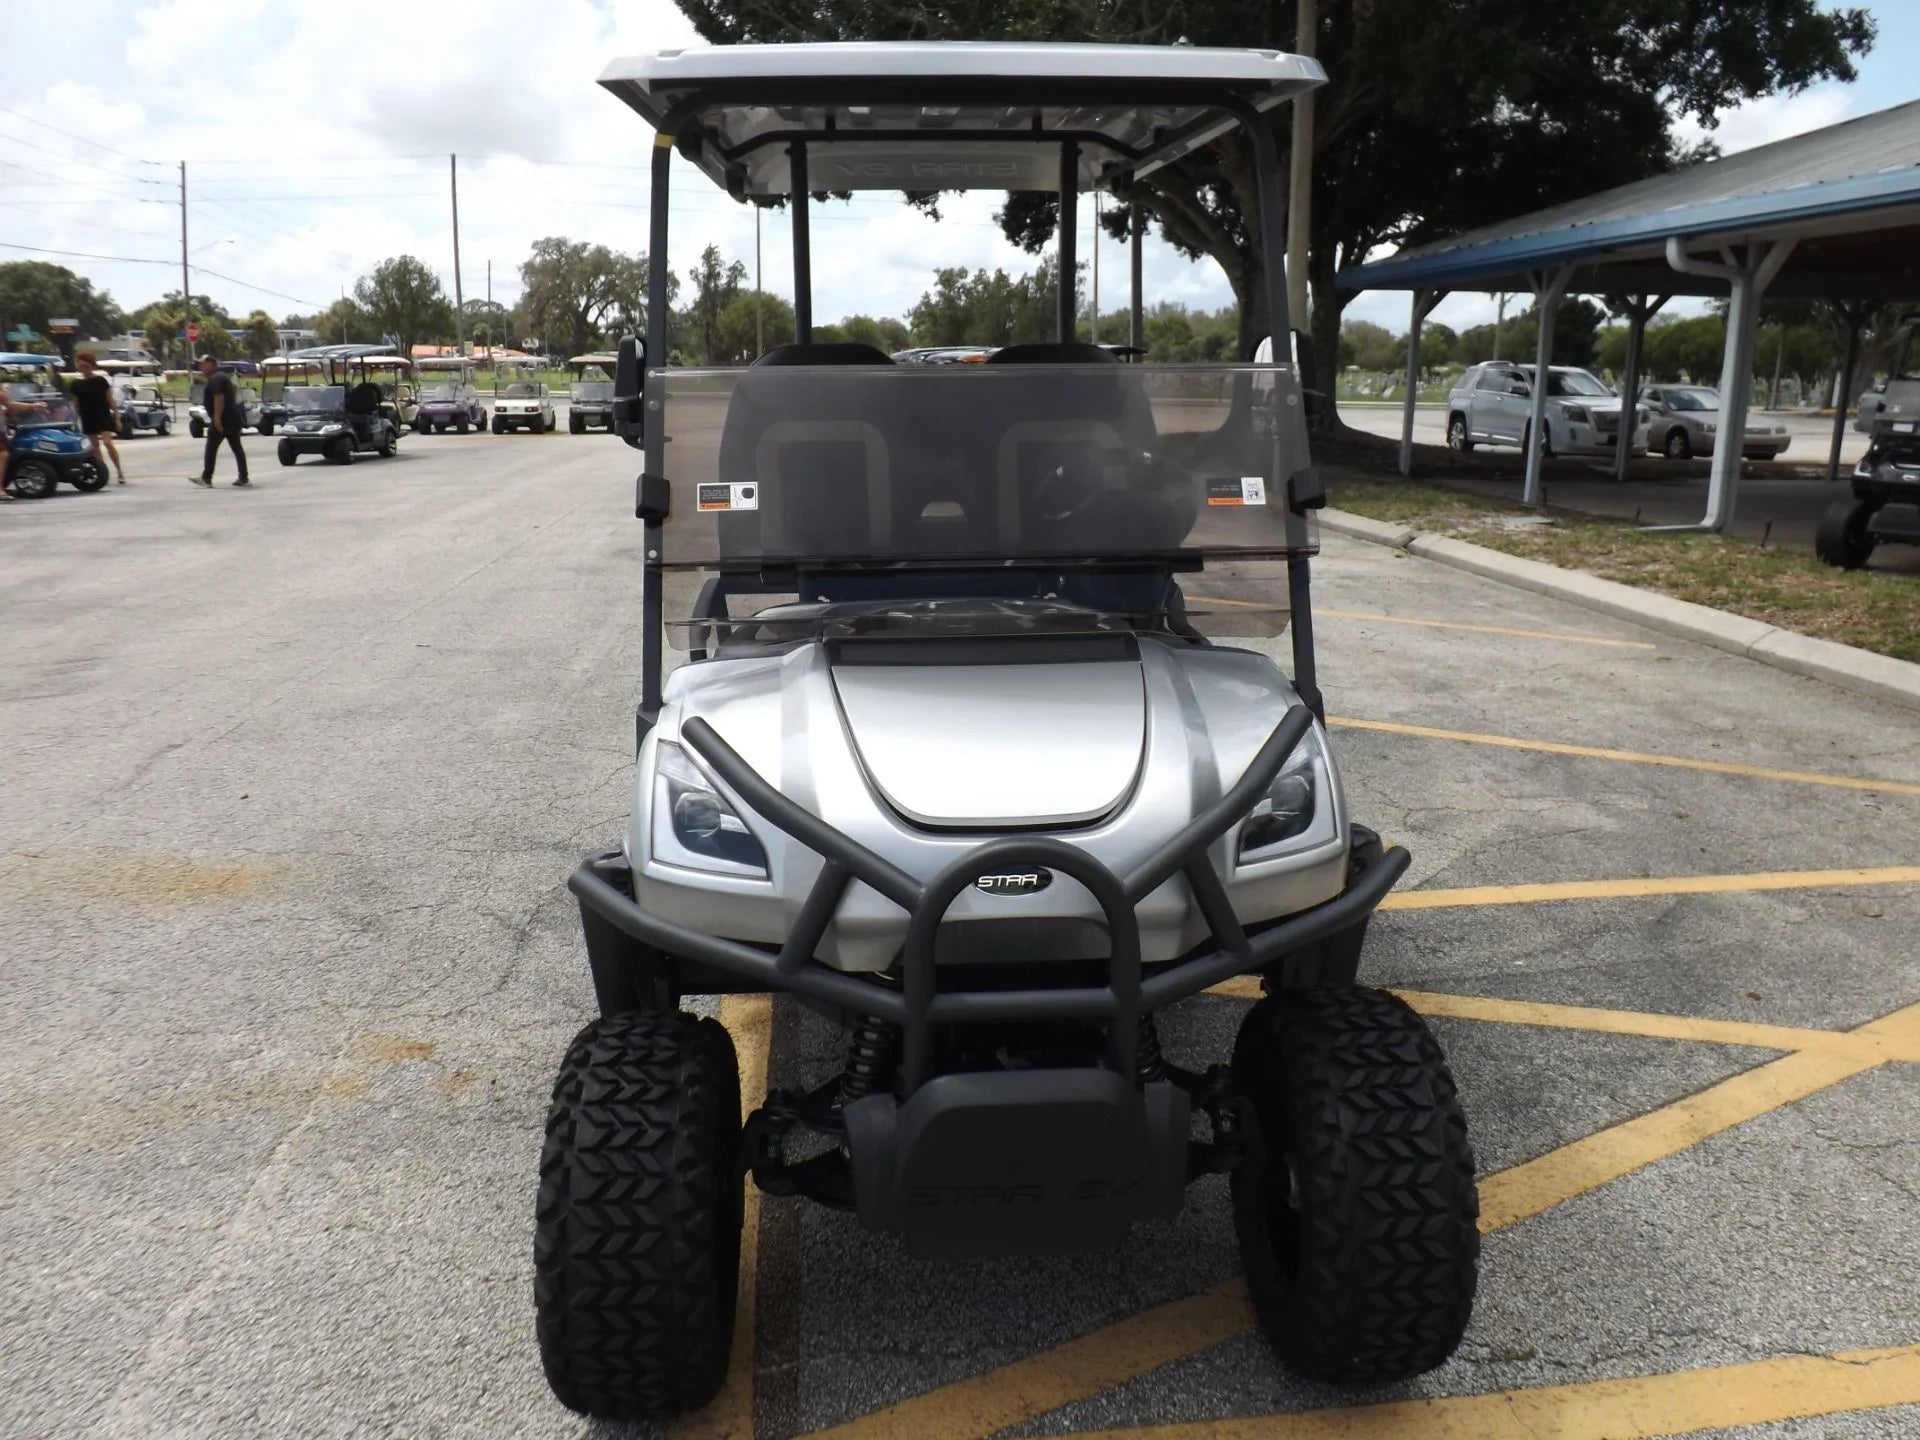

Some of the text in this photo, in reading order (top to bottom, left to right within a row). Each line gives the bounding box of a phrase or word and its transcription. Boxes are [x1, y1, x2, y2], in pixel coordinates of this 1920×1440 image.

[977, 873, 1038, 887] STAR
[908, 1176, 1143, 1208] STAR EV
